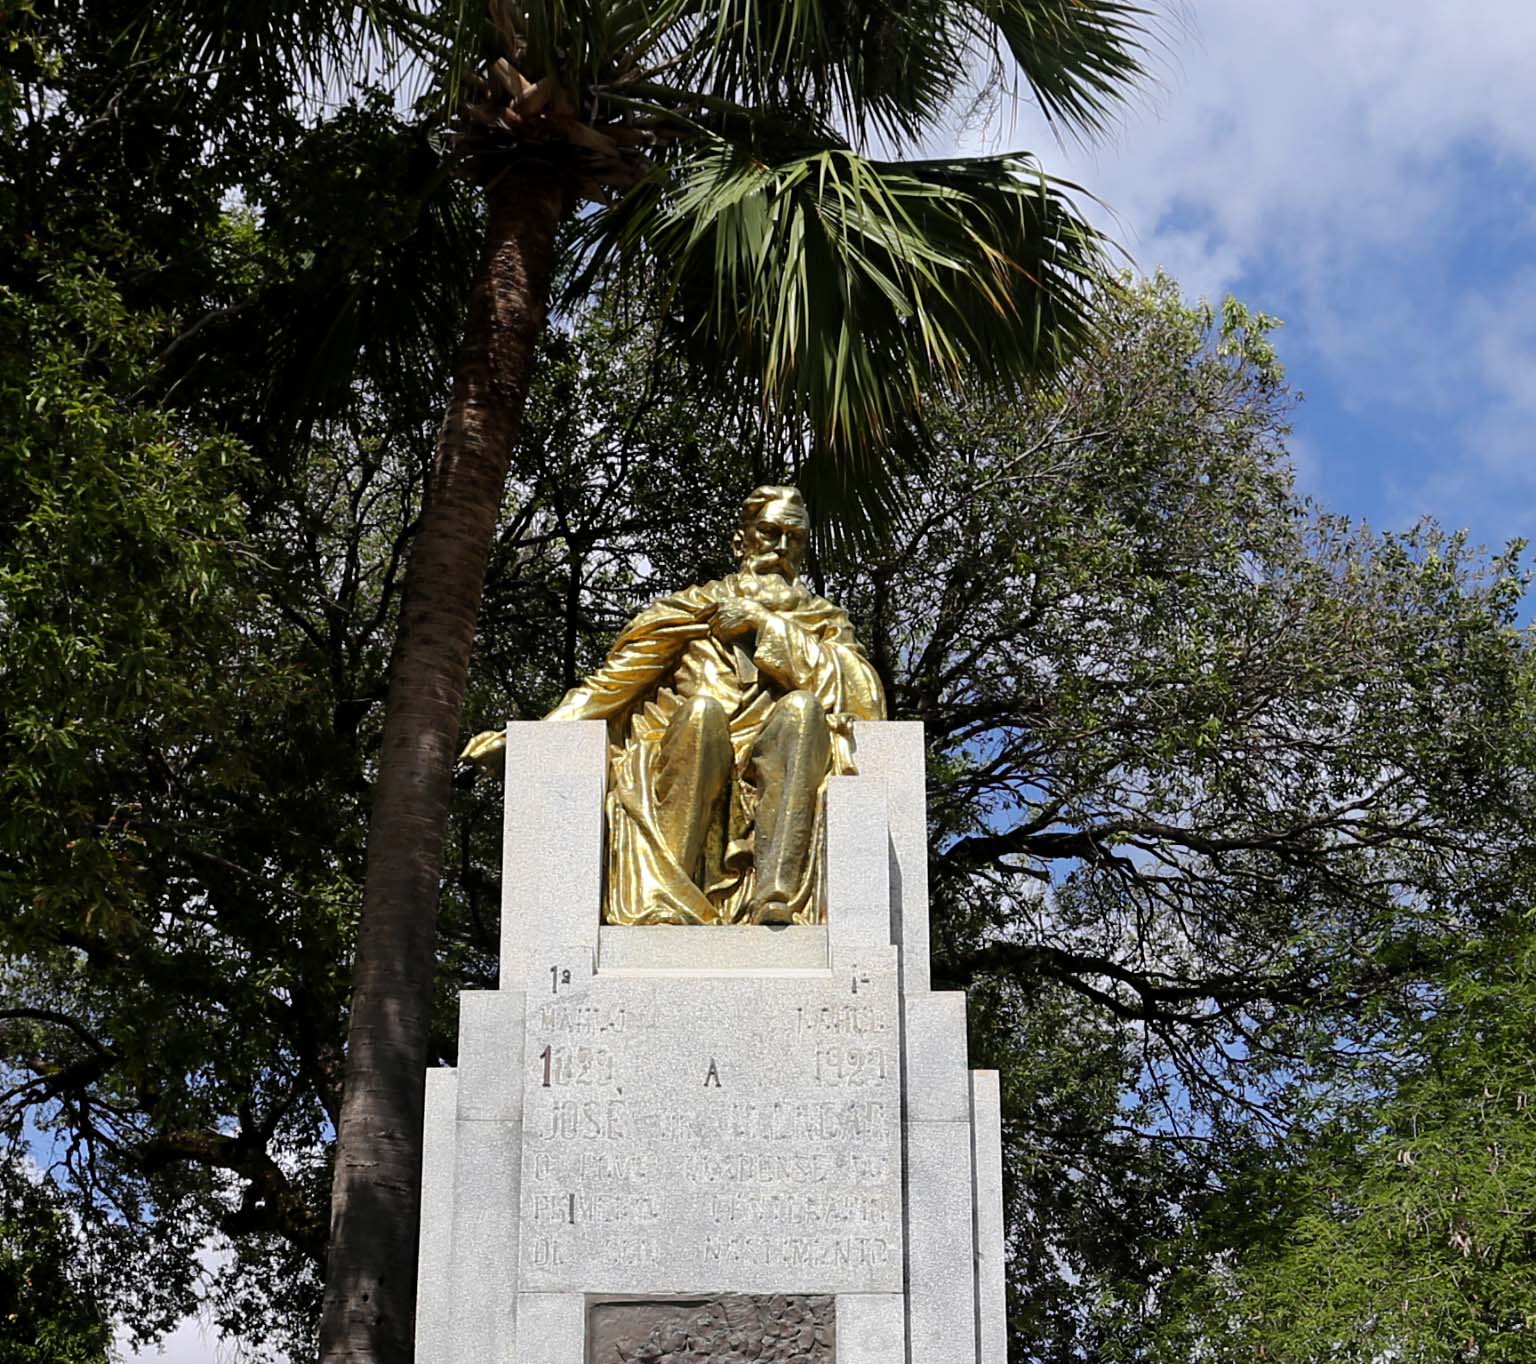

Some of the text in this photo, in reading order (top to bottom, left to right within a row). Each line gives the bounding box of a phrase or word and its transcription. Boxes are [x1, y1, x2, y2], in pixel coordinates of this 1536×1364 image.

[539, 1045, 887, 1089] 1829 A 1929
